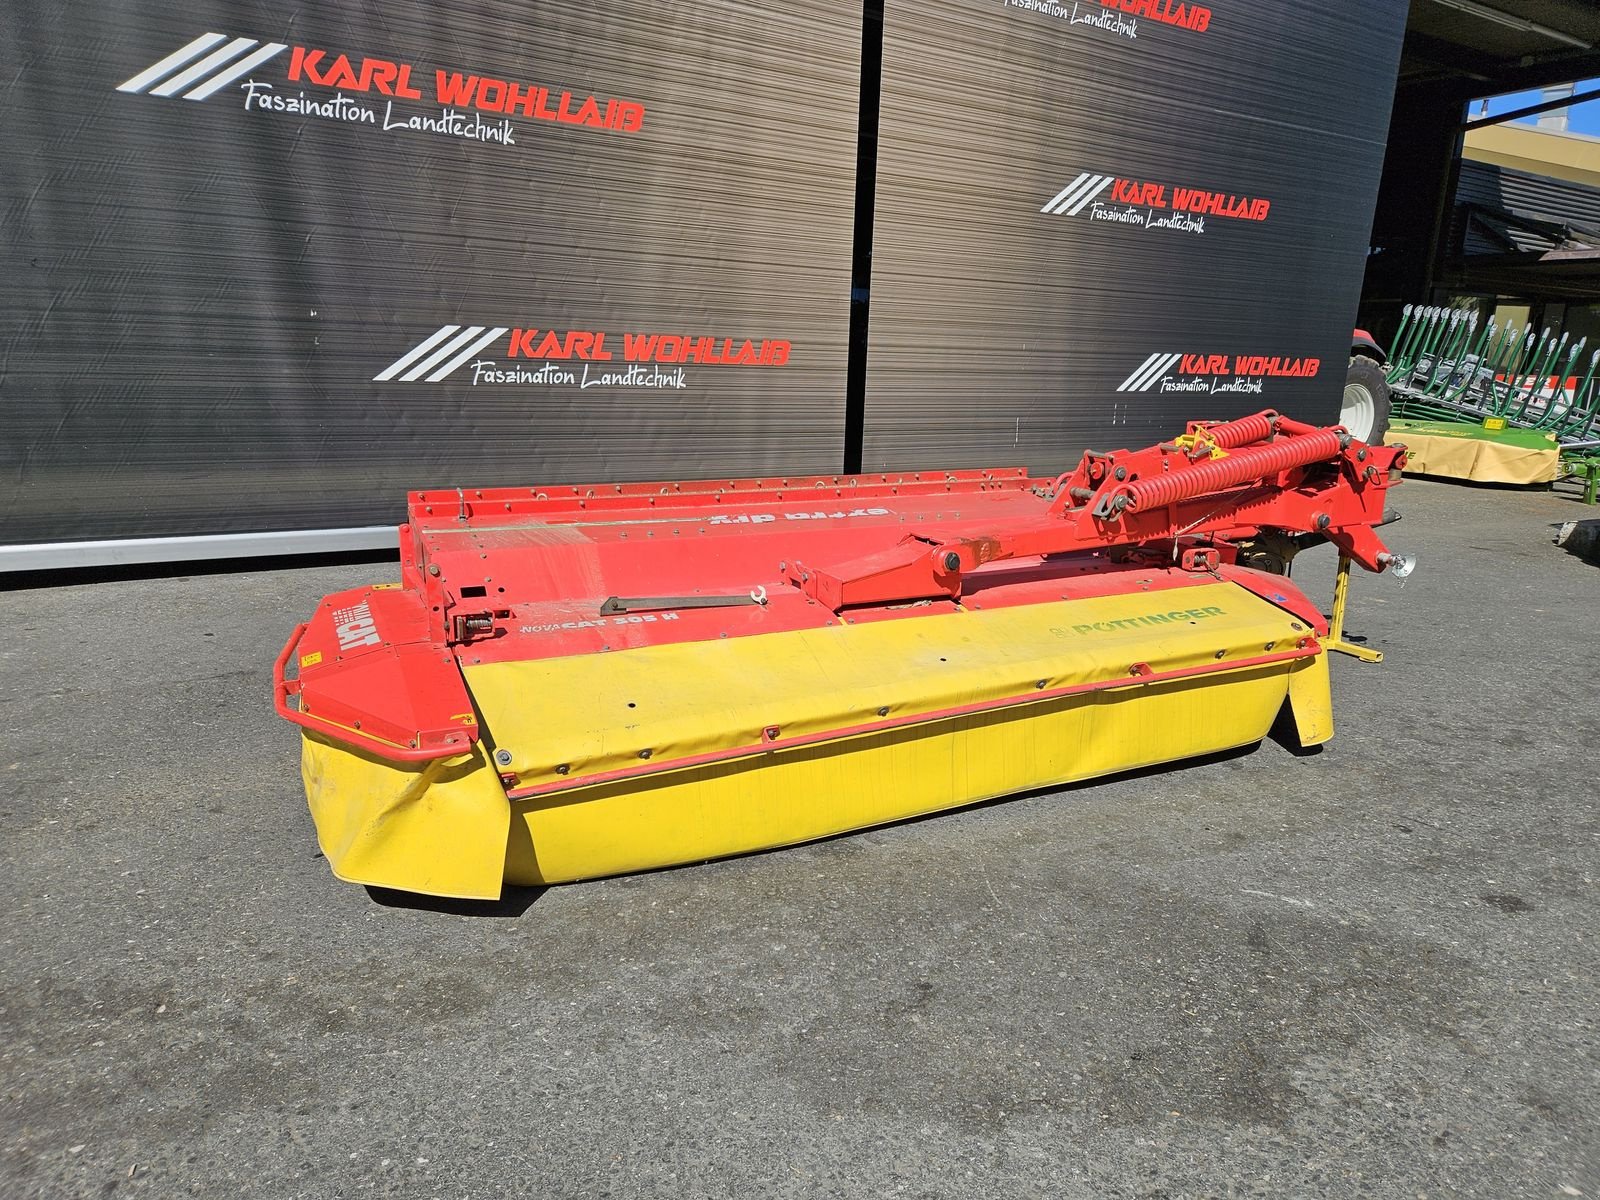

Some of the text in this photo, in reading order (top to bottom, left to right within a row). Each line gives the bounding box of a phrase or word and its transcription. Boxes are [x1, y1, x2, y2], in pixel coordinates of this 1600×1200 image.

[1070, 2, 1137, 38] Landtechnik
[288, 46, 422, 100] KARL
[241, 78, 516, 146] Faszination Landtechnik
[1110, 178, 1167, 209] KARL
[1090, 200, 1205, 234] Faszination Landtechnik
[507, 328, 613, 361] KARL
[470, 359, 687, 389] Faszination Landtechnik
[1178, 354, 1231, 375] KARL
[1160, 375, 1263, 395] Faszination Landtechnik
[613, 614, 658, 626] 305
[661, 612, 680, 621] H
[1071, 605, 1228, 636] PÖTTINGER
